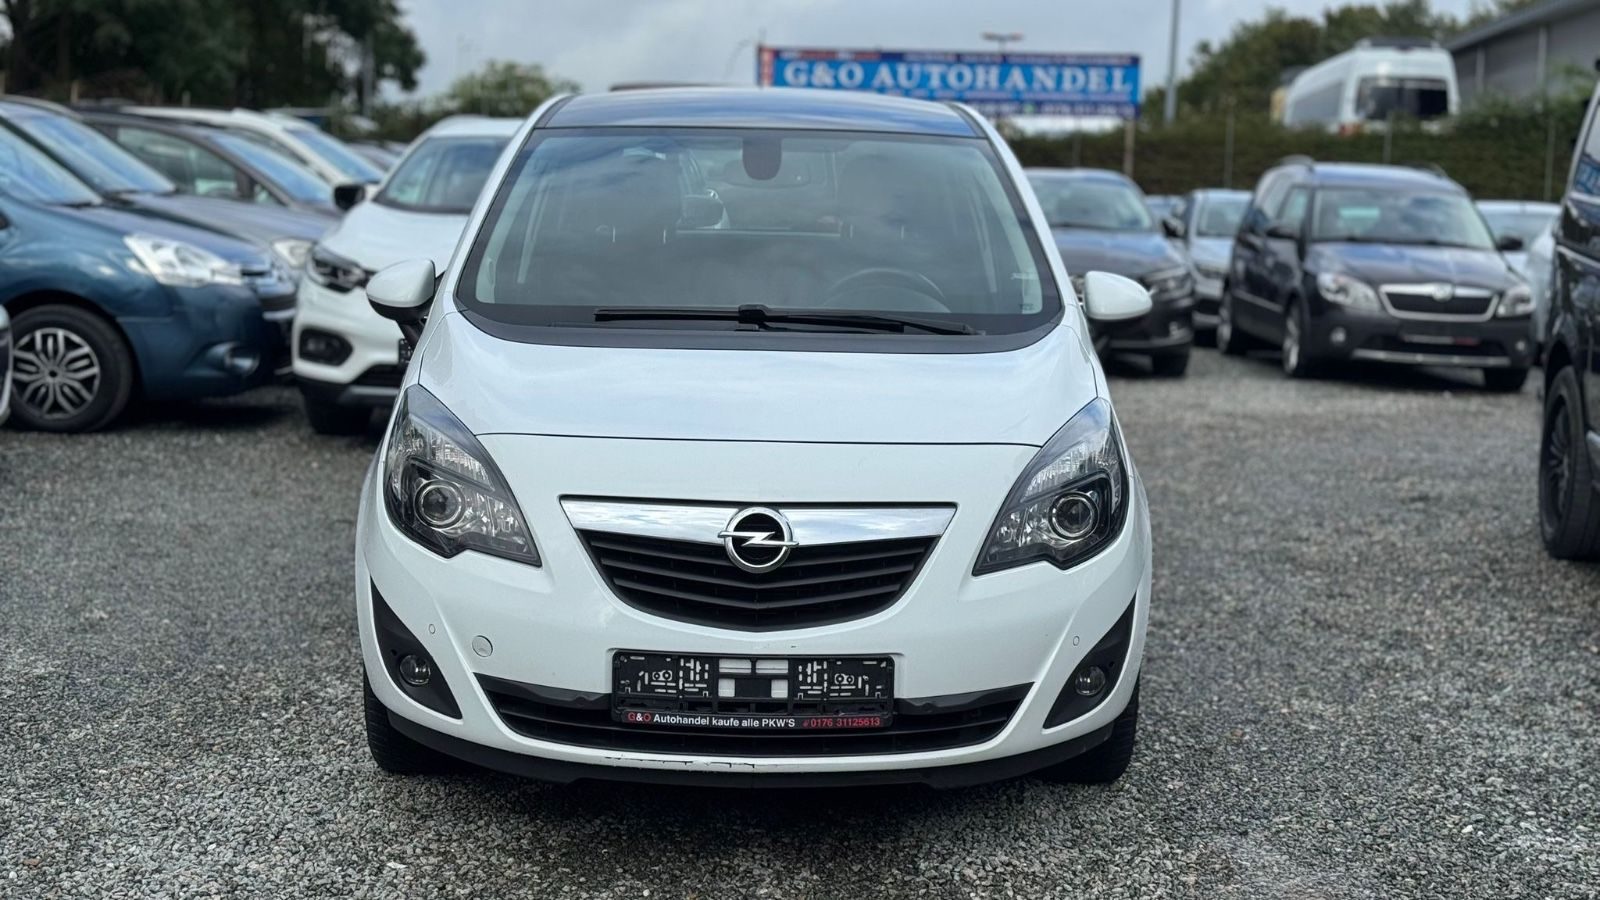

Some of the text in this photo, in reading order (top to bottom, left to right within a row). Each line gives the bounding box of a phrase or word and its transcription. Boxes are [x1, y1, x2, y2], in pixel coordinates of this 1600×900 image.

[783, 61, 864, 88] G&O
[872, 63, 1131, 92] AUTOHANDEL
[628, 712, 651, 722] G&O
[653, 714, 709, 725] Autohandel
[712, 717, 740, 727] kaufe
[741, 718, 760, 728] alle
[761, 719, 795, 728] PKW'S
